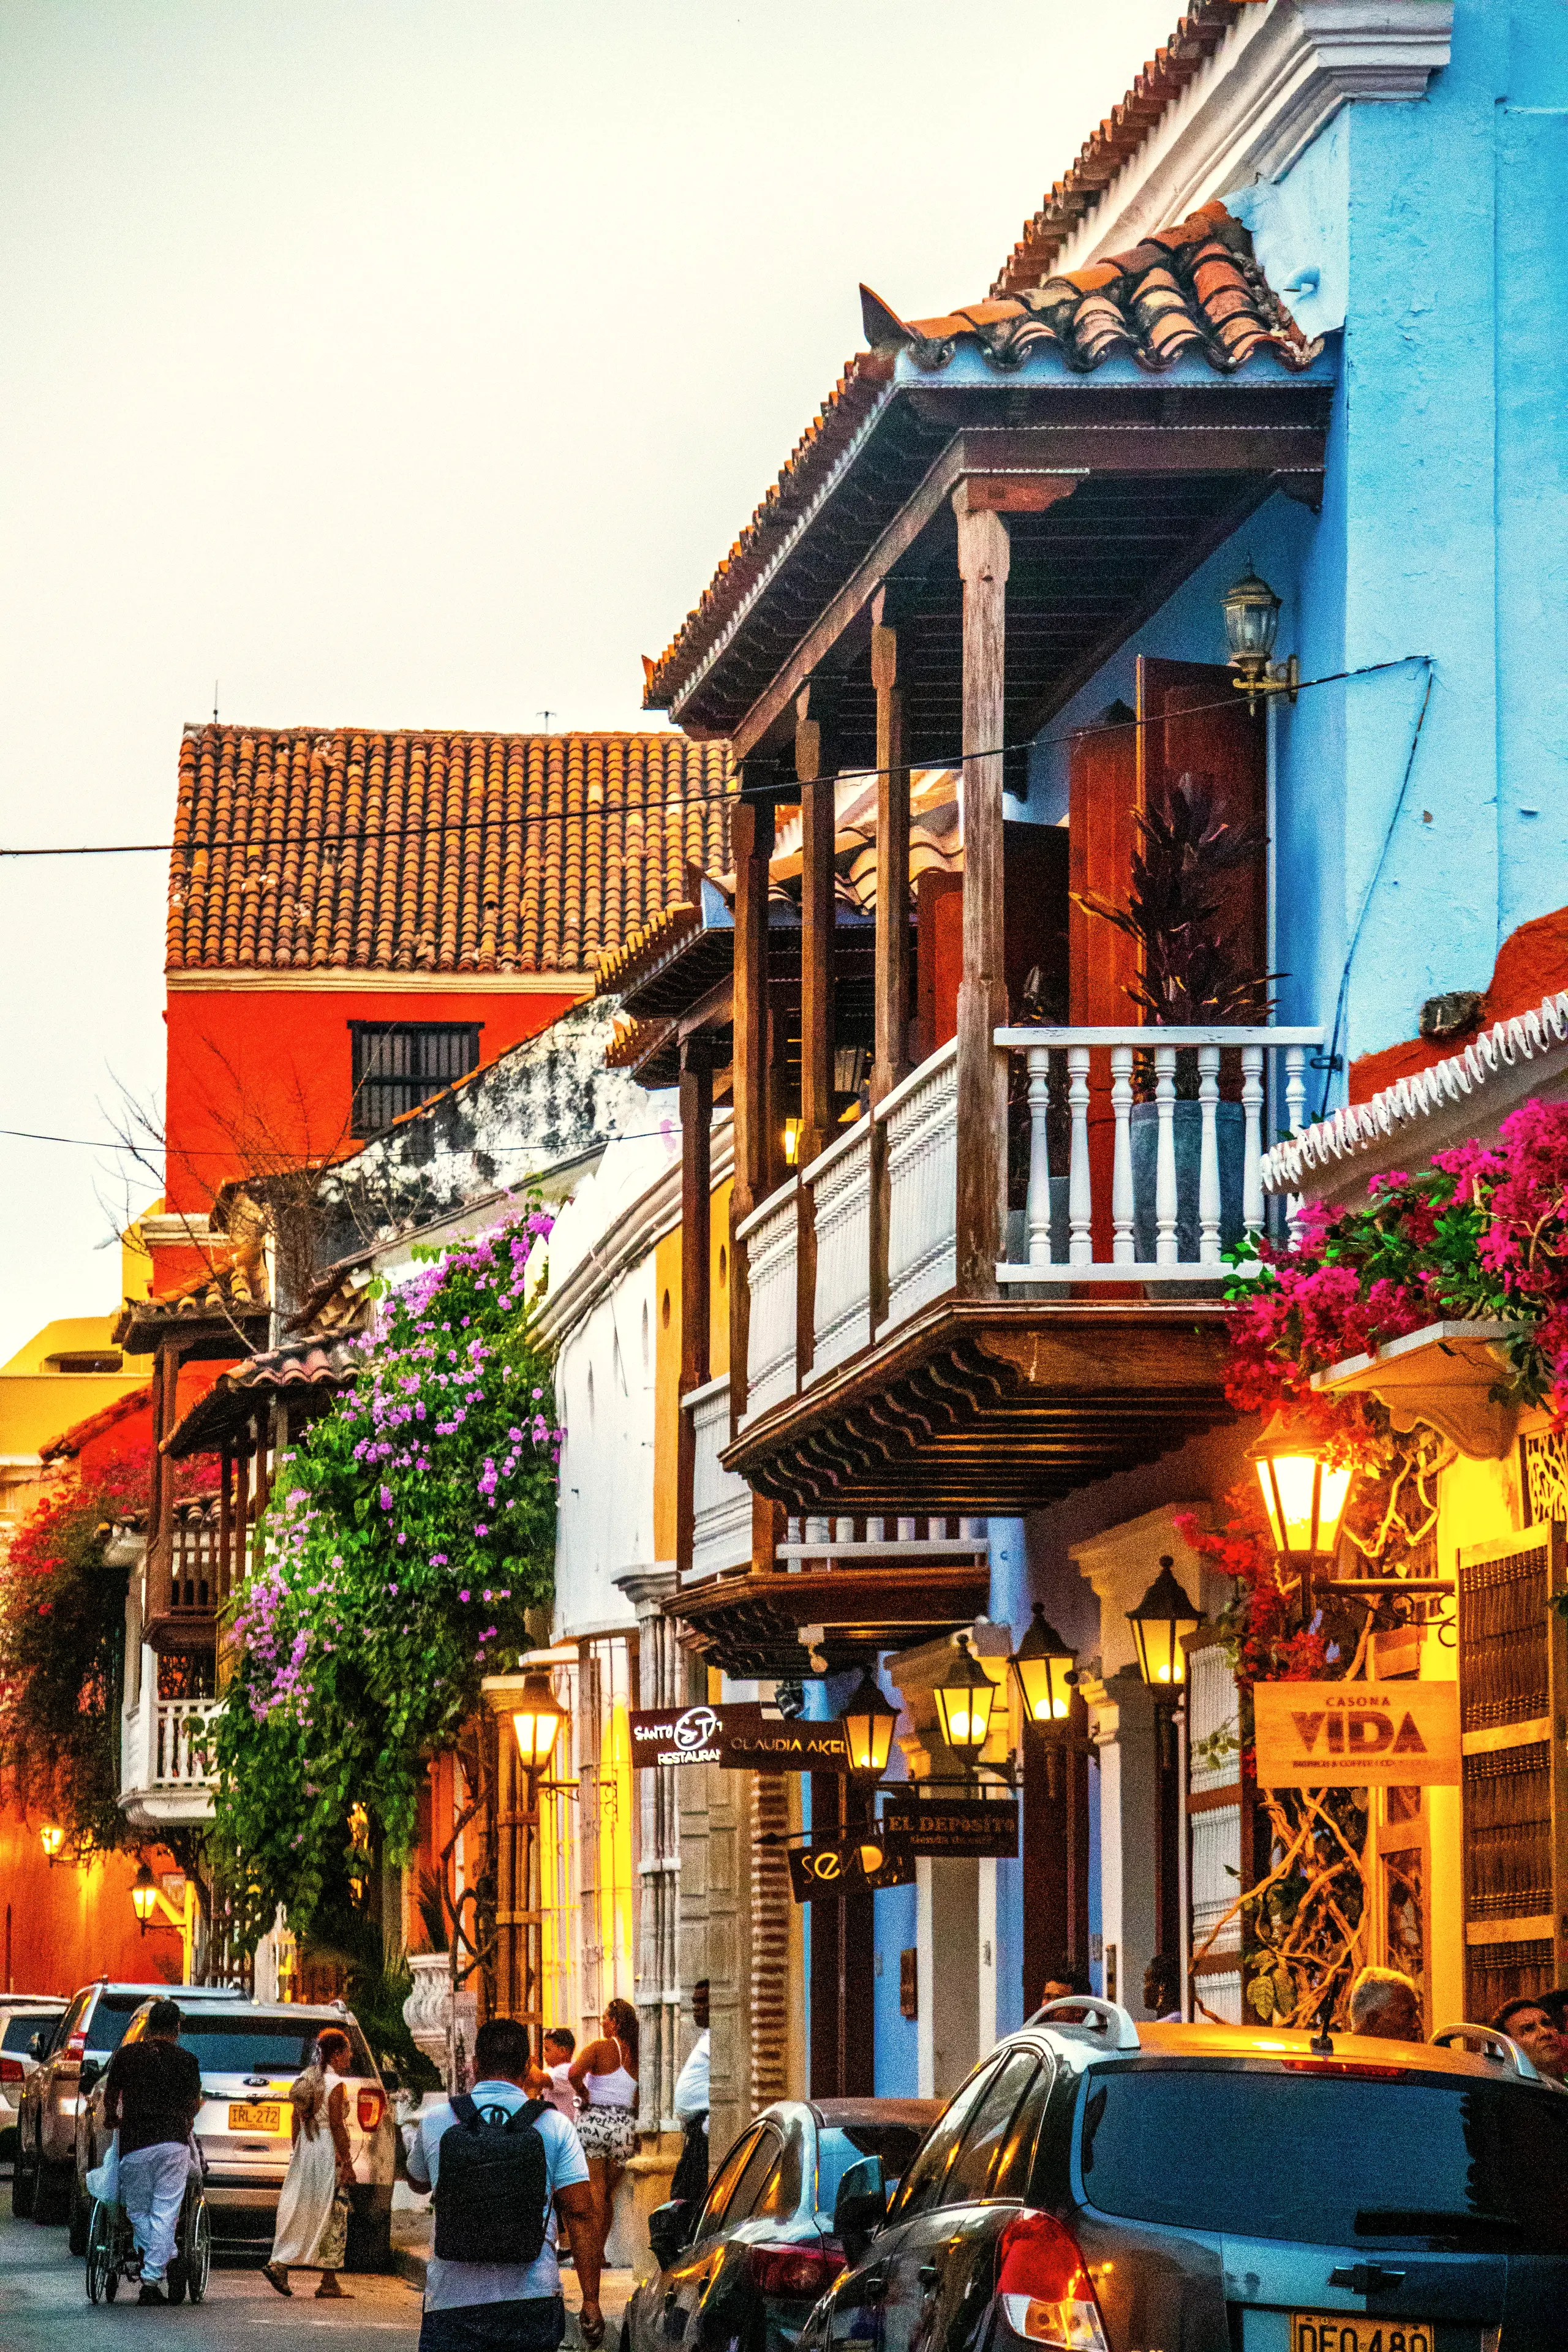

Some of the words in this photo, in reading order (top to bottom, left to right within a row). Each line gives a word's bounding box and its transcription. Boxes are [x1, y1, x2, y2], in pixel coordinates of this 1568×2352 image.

[1325, 1697, 1391, 1707] CASONA
[634, 1724, 673, 1741] SANTO
[1291, 1711, 1428, 1754] VIDA
[731, 1737, 803, 1752] CLAUDIA
[888, 1816, 914, 1831] EL
